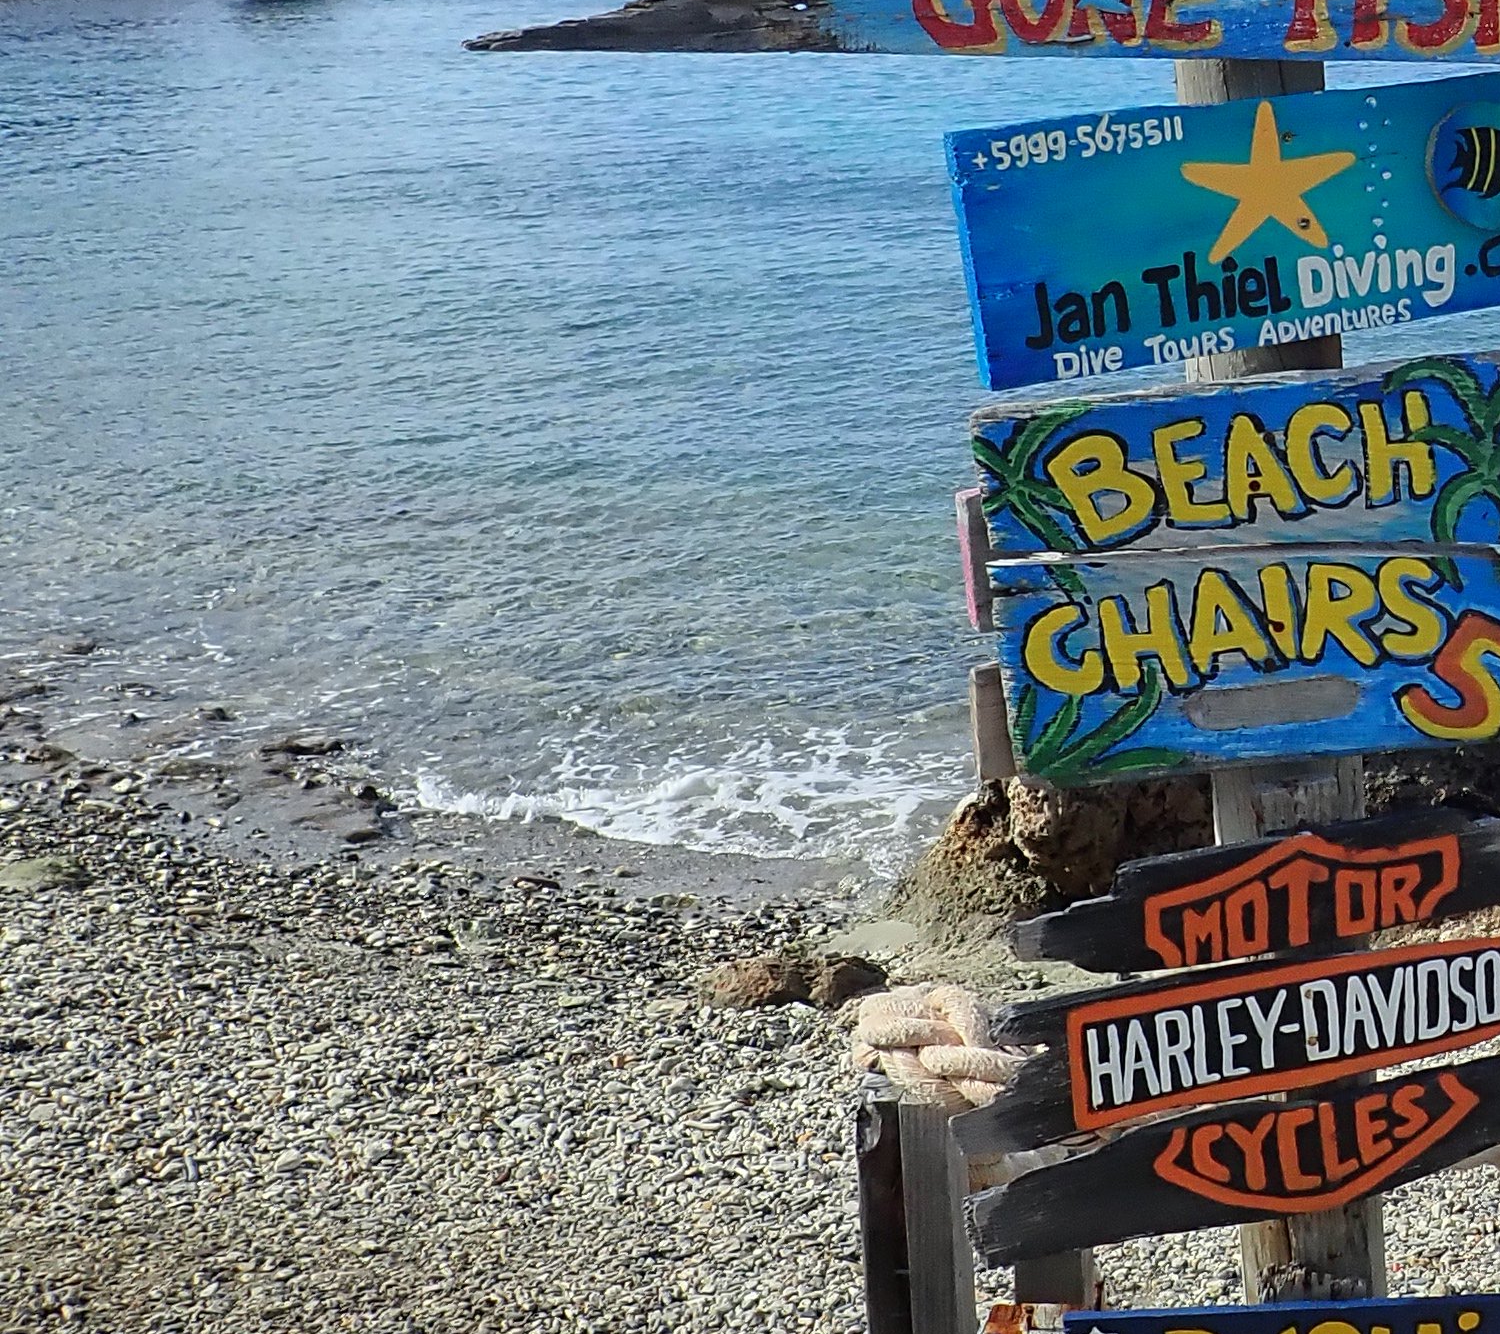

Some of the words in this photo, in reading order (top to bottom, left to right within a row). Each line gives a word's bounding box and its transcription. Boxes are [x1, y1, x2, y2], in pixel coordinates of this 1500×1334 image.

[972, 113, 1184, 170] +5999-5675511
[1026, 273, 1130, 351] Jan
[1141, 250, 1290, 329] Thiel
[1053, 340, 1124, 381] Dive
[1045, 389, 1438, 547] BEACH
[1024, 556, 1449, 697] CHAIRS
[1182, 862, 1423, 964] MOTOR
[1192, 1080, 1430, 1192] CYCLES
